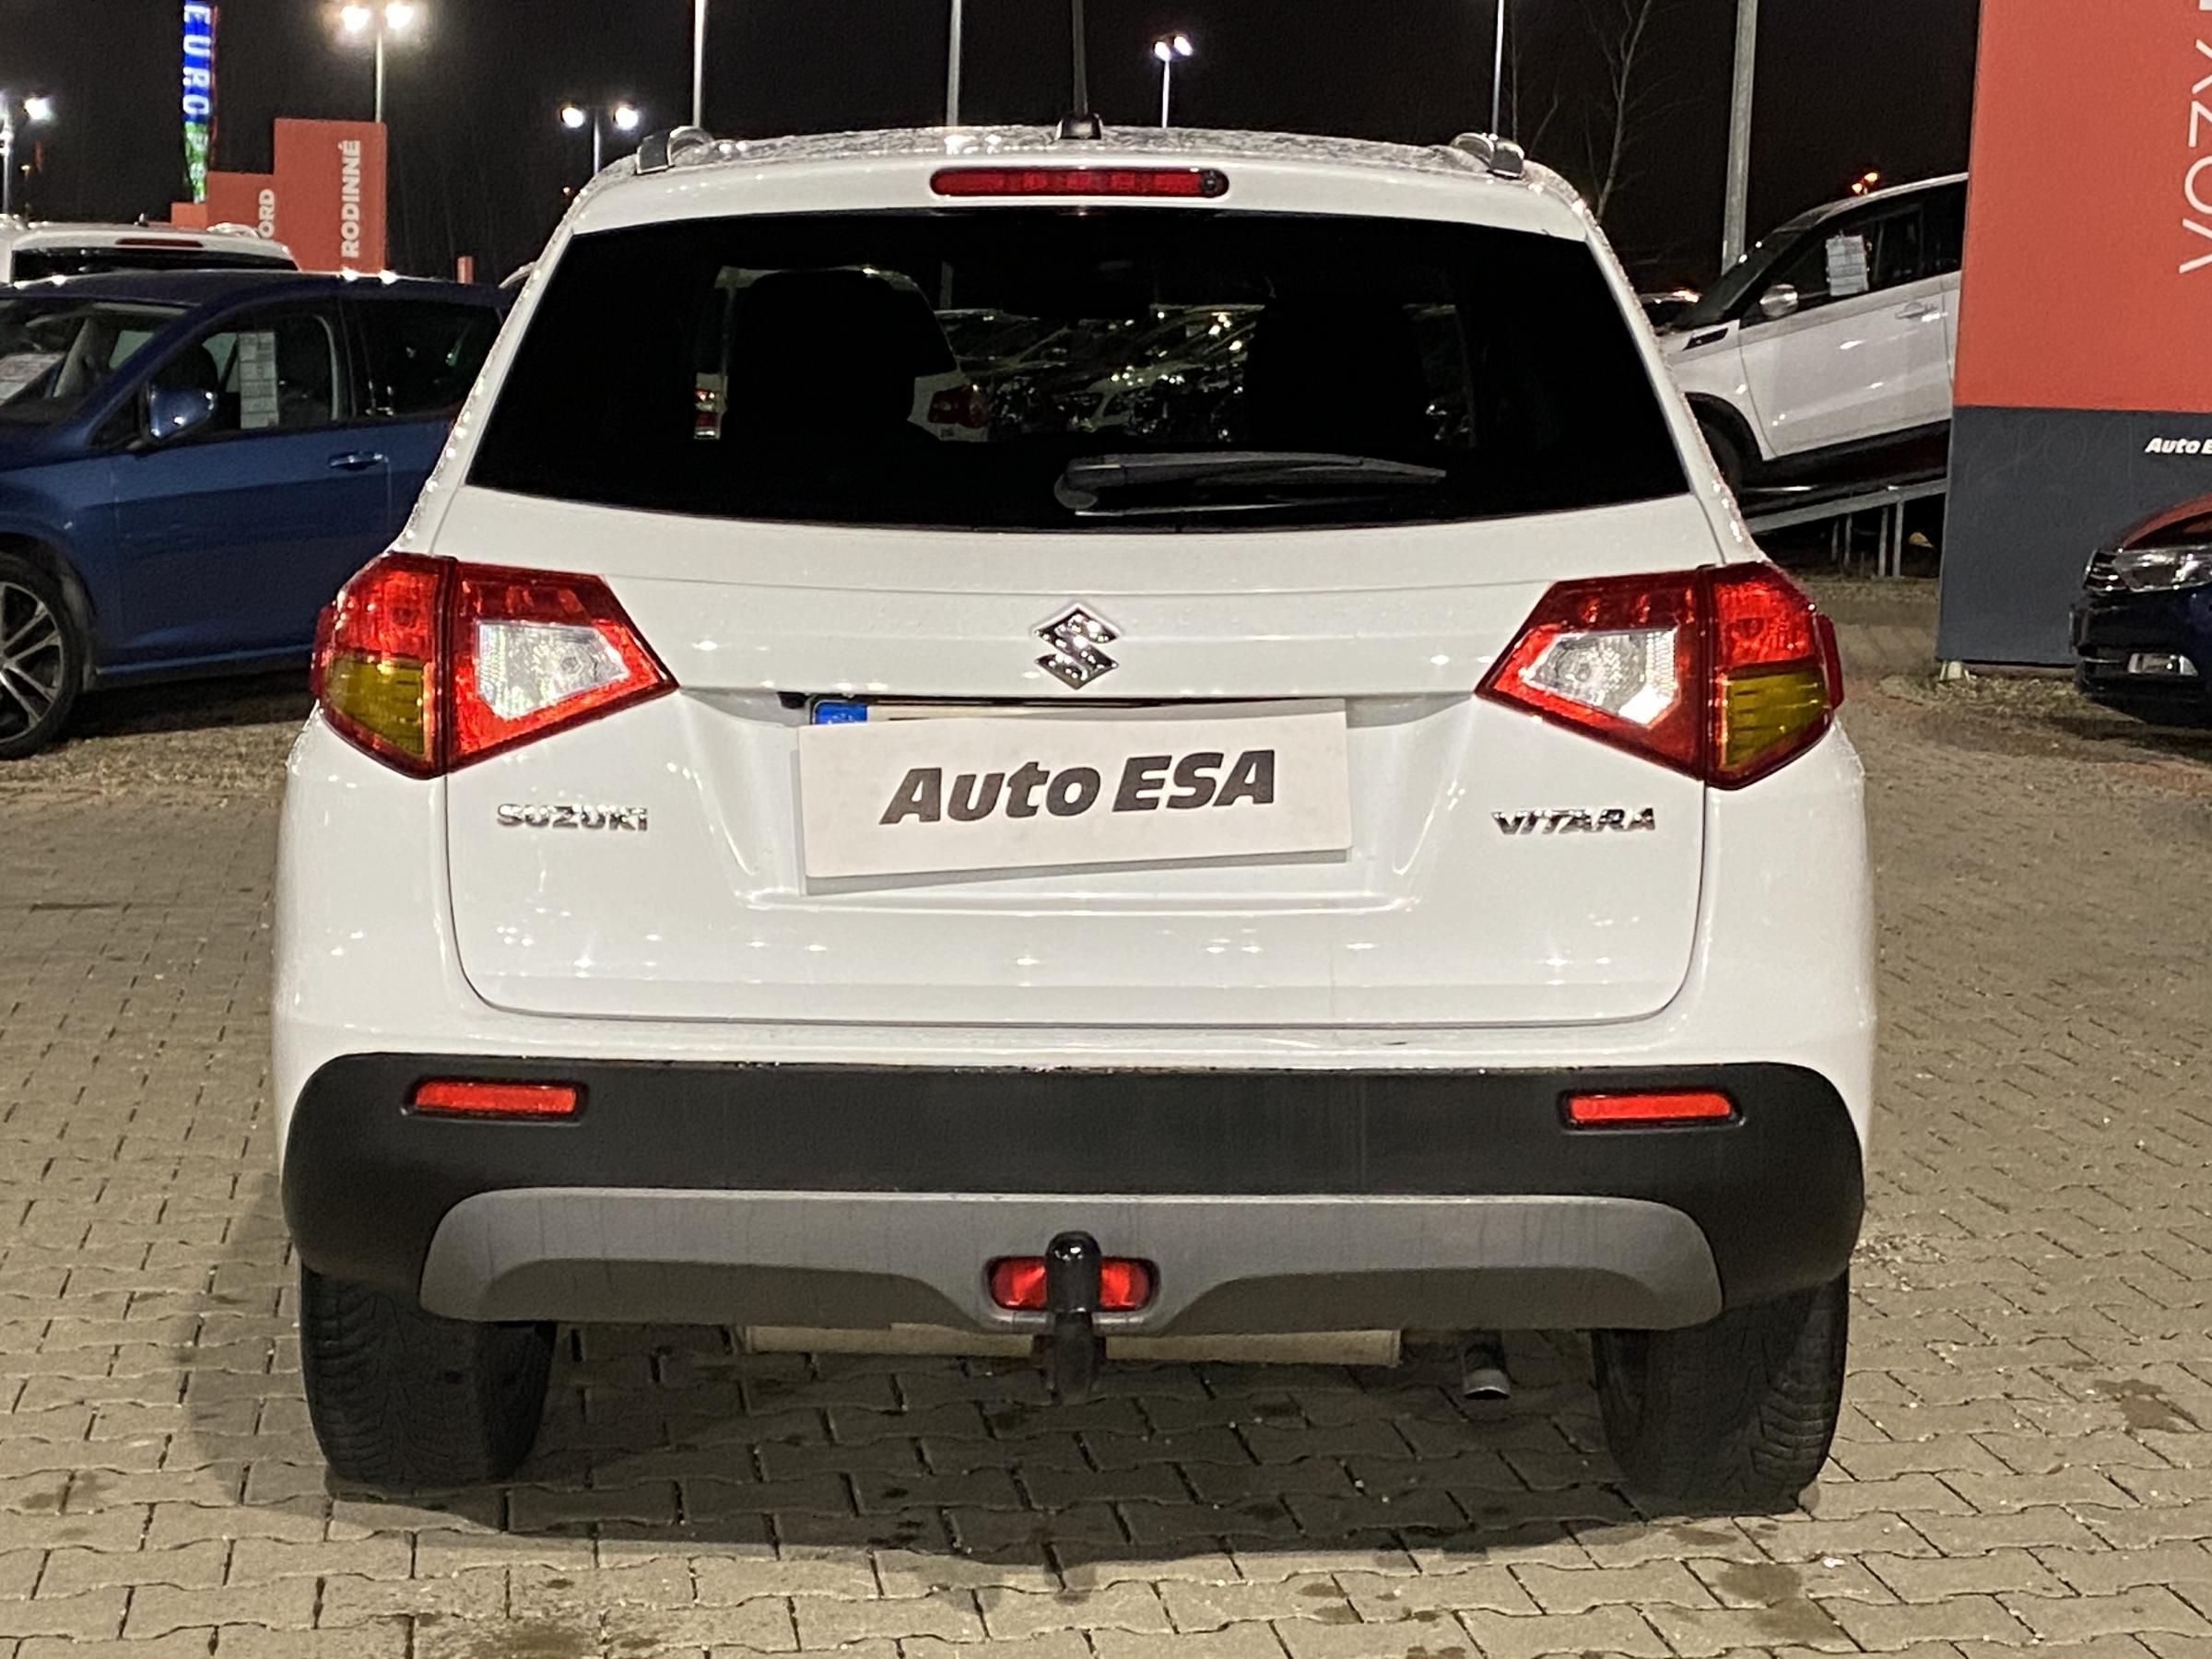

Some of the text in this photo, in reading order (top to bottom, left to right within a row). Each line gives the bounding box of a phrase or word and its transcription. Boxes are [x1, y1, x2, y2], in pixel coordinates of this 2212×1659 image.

[258, 188, 275, 239] ORD
[337, 140, 360, 259] RODINNÉ
[2144, 437, 2201, 454] Auto
[878, 749, 1275, 824] Auto ESA
[496, 803, 648, 831] SUZUKI
[1490, 807, 1655, 835] VITARA
